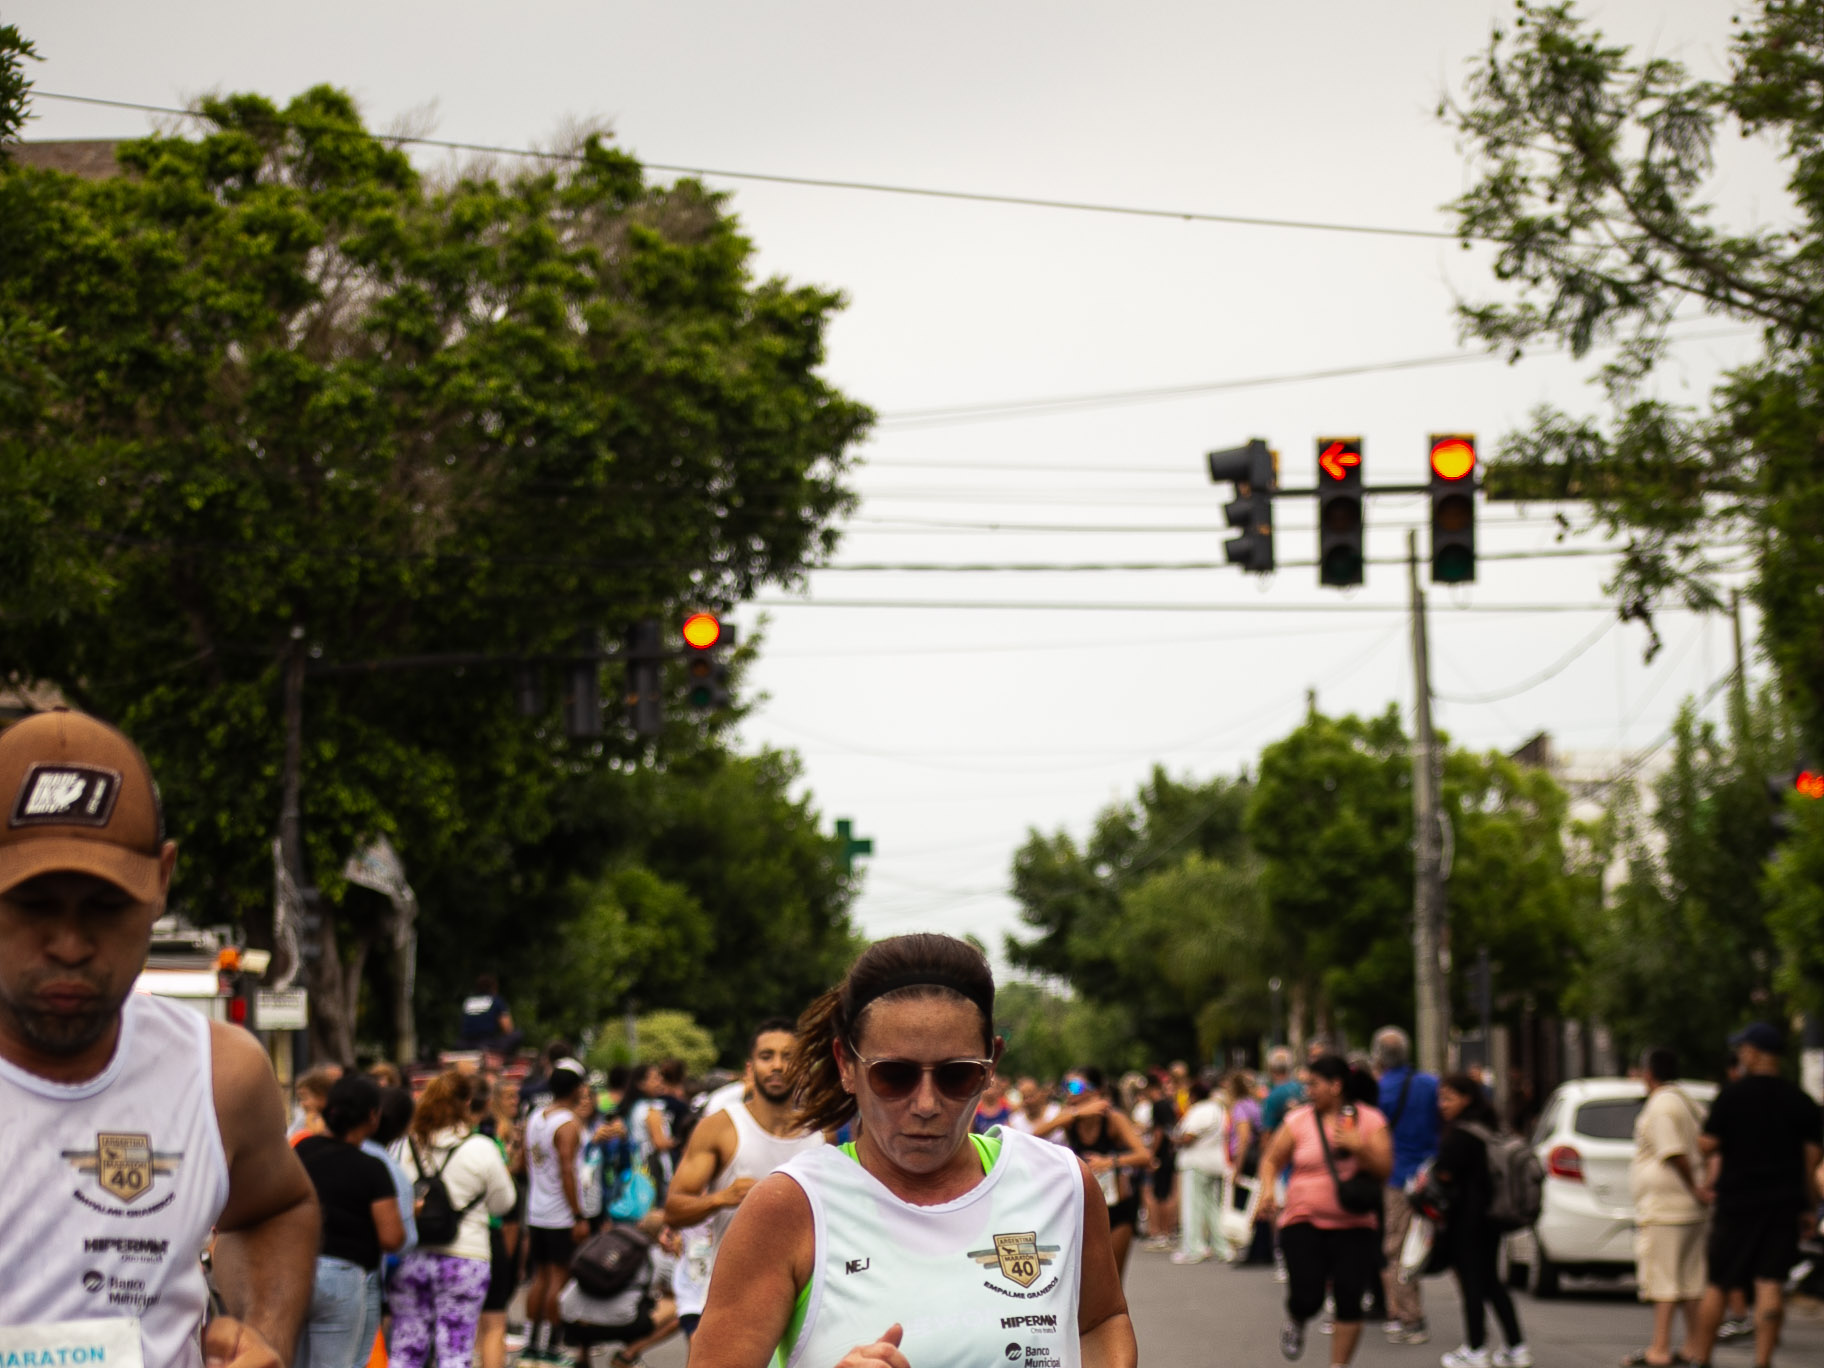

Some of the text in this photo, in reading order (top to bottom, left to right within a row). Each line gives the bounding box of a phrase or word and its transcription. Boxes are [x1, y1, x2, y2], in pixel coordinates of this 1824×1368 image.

[111, 1171, 142, 1189] 40
[845, 1258, 870, 1275] NEJ
[1011, 1261, 1034, 1276] 40
[983, 1276, 1059, 1299] EMPALME GRANEROS
[0, 1347, 105, 1368] ARATON
[1025, 1346, 1050, 1357] Banco
